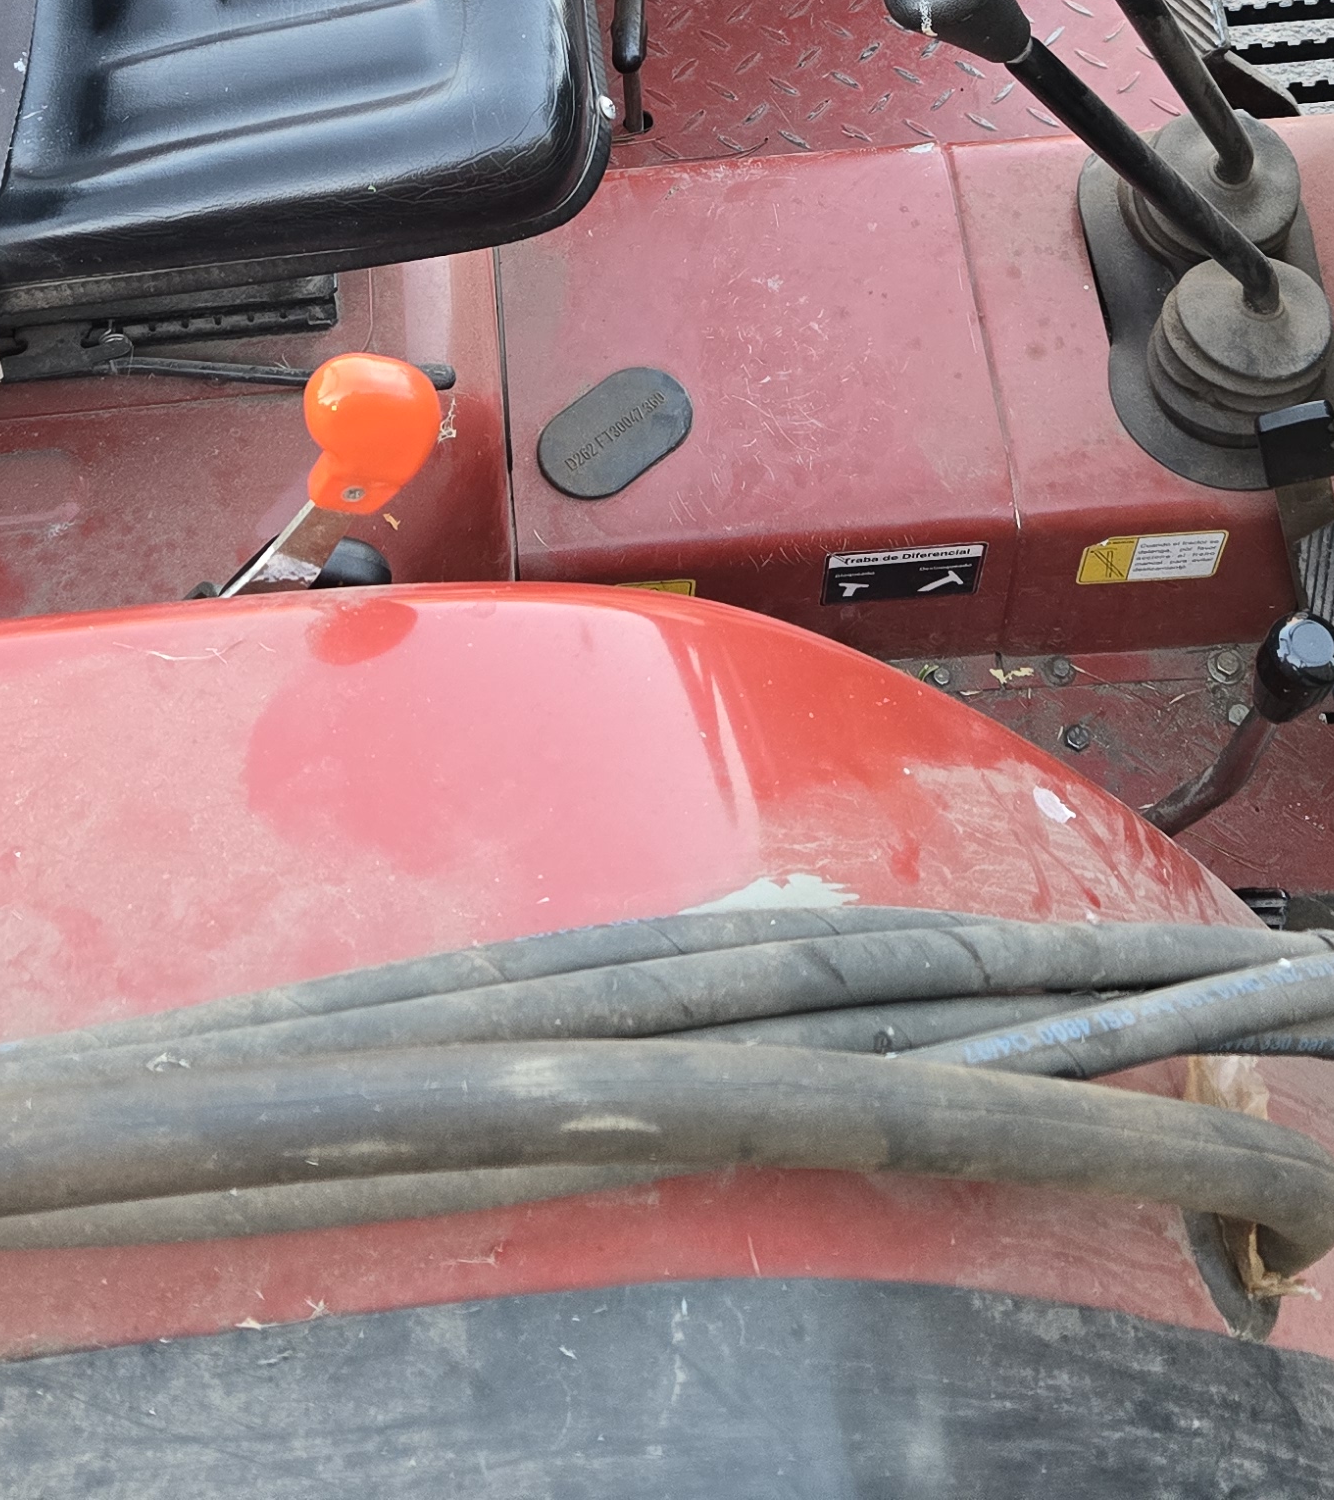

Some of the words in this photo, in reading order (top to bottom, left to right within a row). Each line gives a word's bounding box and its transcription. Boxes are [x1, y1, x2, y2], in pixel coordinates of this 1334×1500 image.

[564, 444, 598, 472] D262
[596, 408, 644, 450] FT30047
[882, 554, 899, 562] de
[902, 548, 971, 561] Diferencial
[1035, 1016, 1091, 1045] 4800
[1093, 1008, 1137, 1033] PSI
